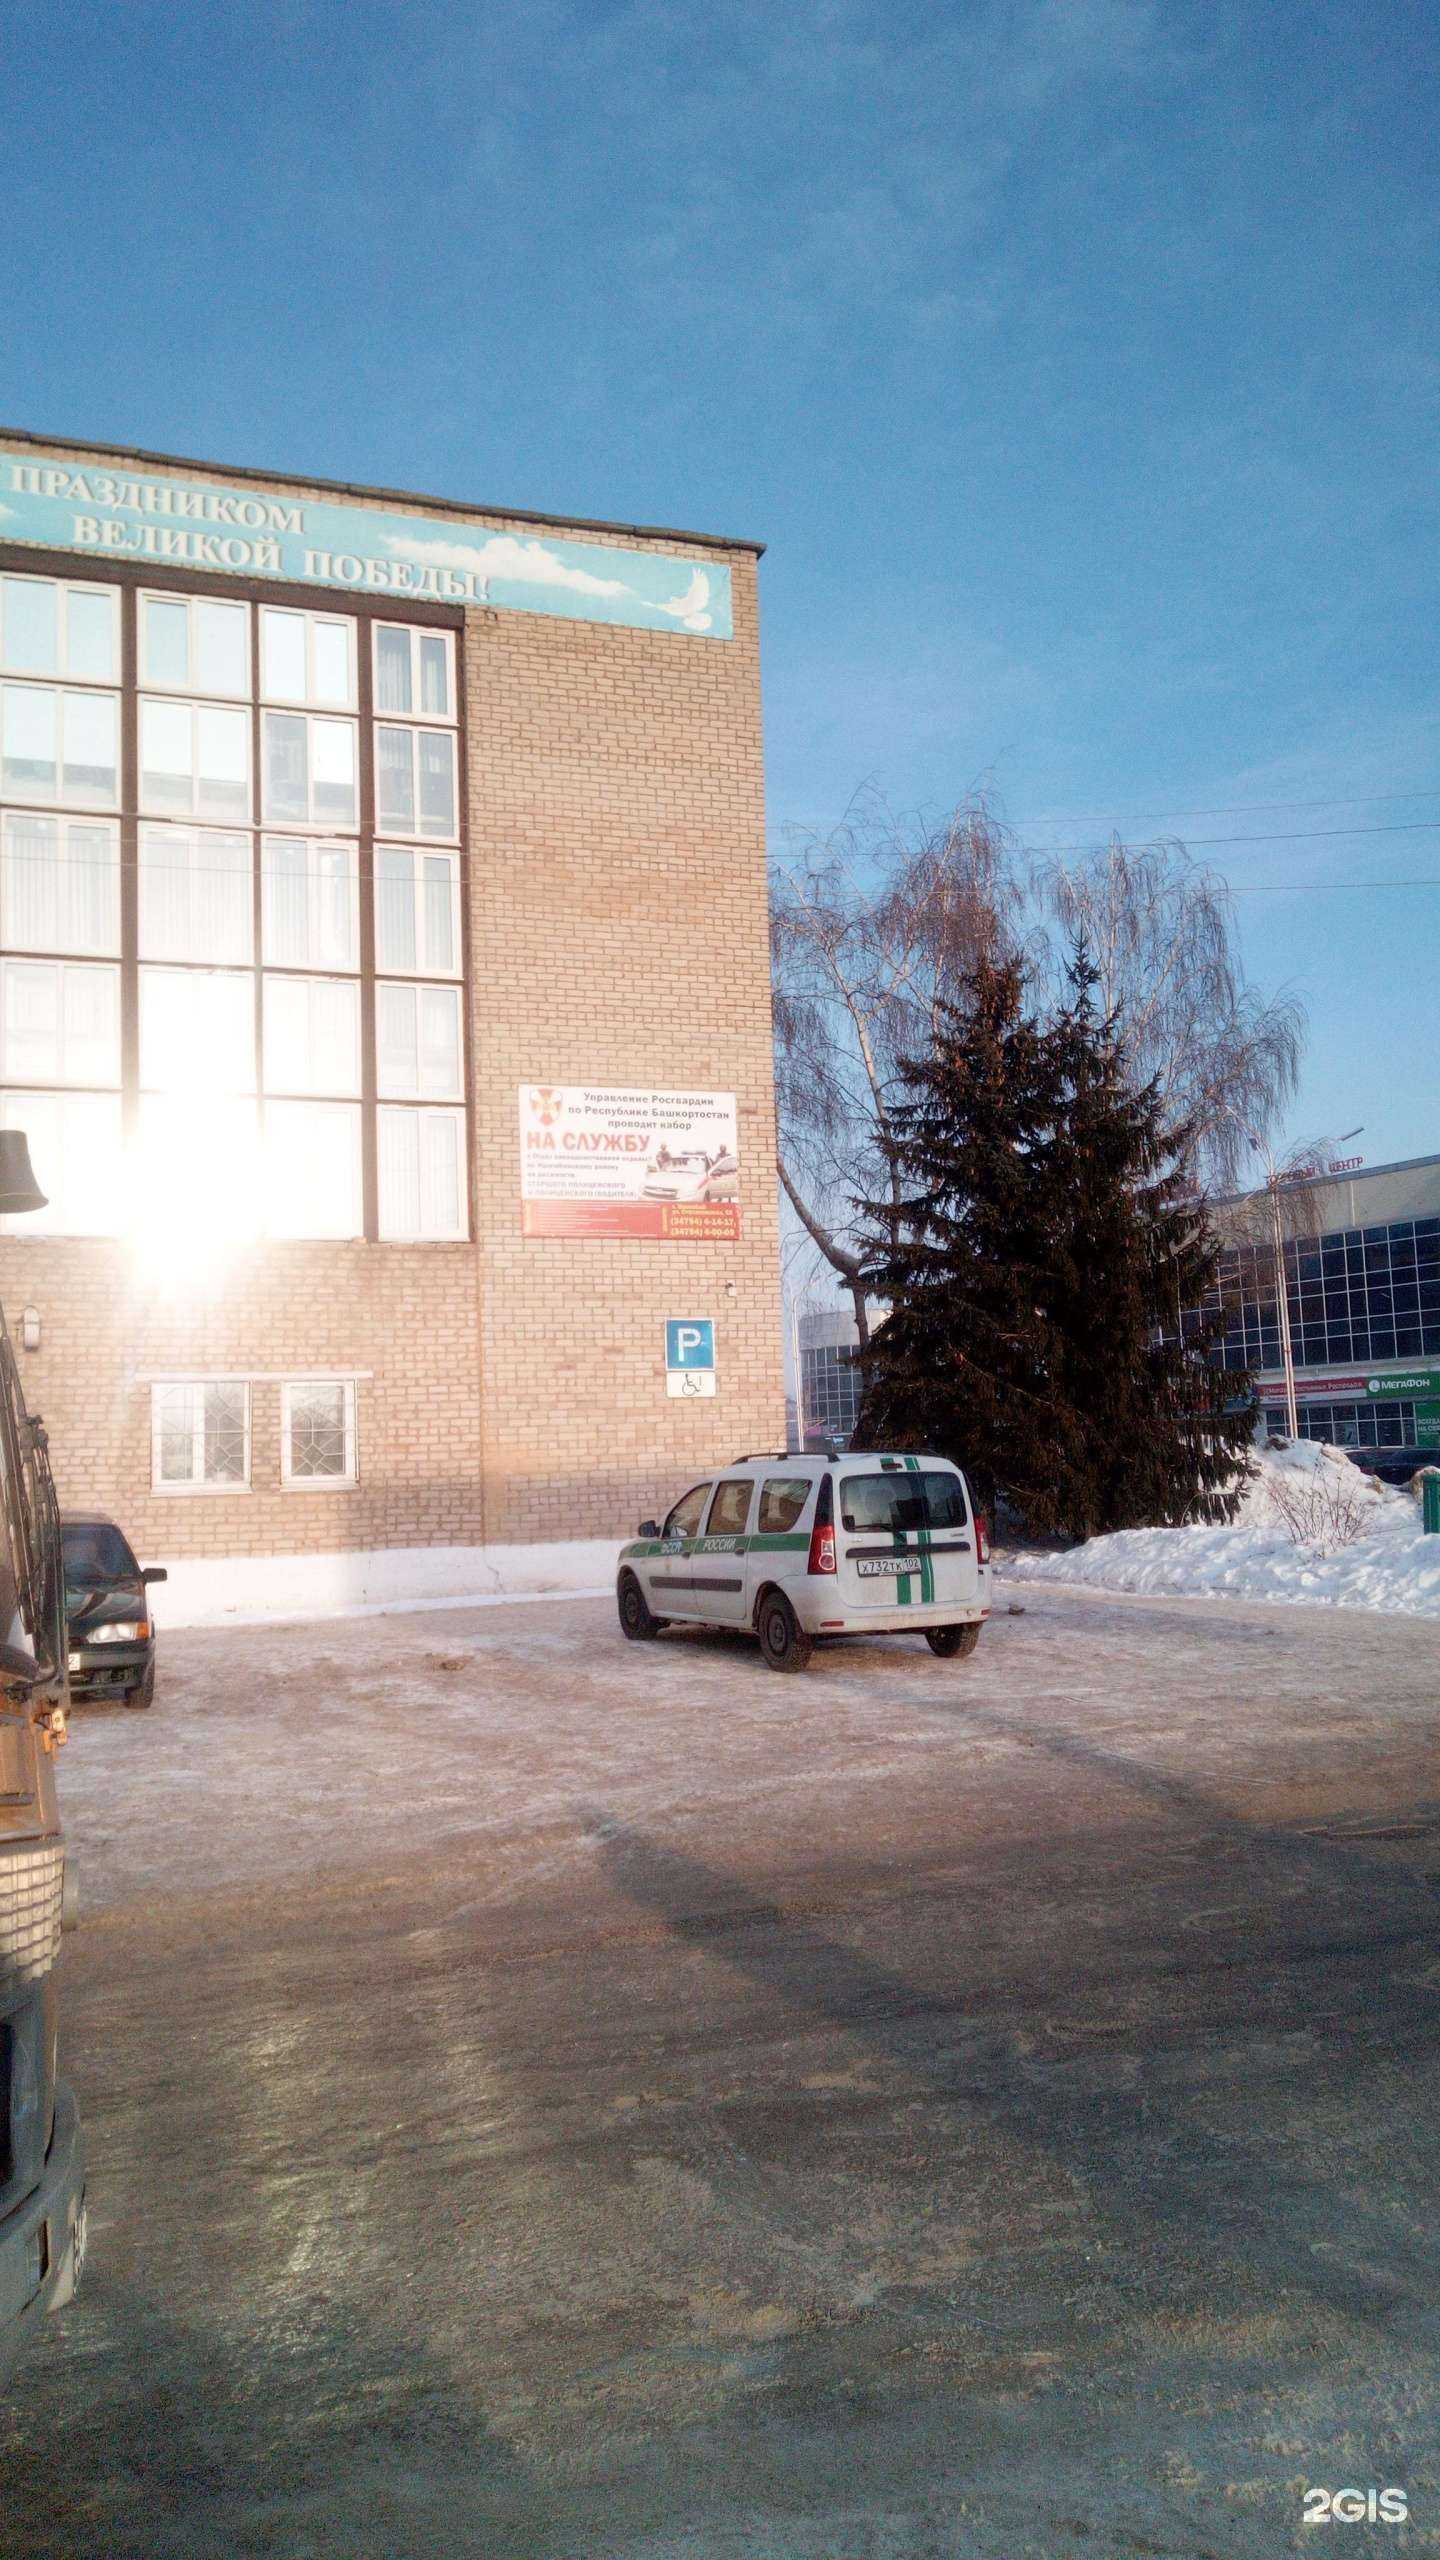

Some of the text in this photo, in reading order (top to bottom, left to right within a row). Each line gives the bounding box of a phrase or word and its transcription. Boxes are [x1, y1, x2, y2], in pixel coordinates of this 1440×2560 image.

[11, 464, 306, 535] ПРАЗДНИКОМ
[70, 513, 490, 600] ВЕЛИКОЙ ПОБЕДЫ!
[584, 1092, 714, 1106] Управление Росгвардии
[568, 1106, 730, 1119] по Республике Башкортостан
[607, 1120, 692, 1131] проводит набор
[527, 1131, 651, 1152] НА СЛУЖБУ
[677, 1328, 701, 1362] P
[1381, 1378, 1430, 1390] МЕГАФОН
[702, 1536, 737, 1553] РОССИИ
